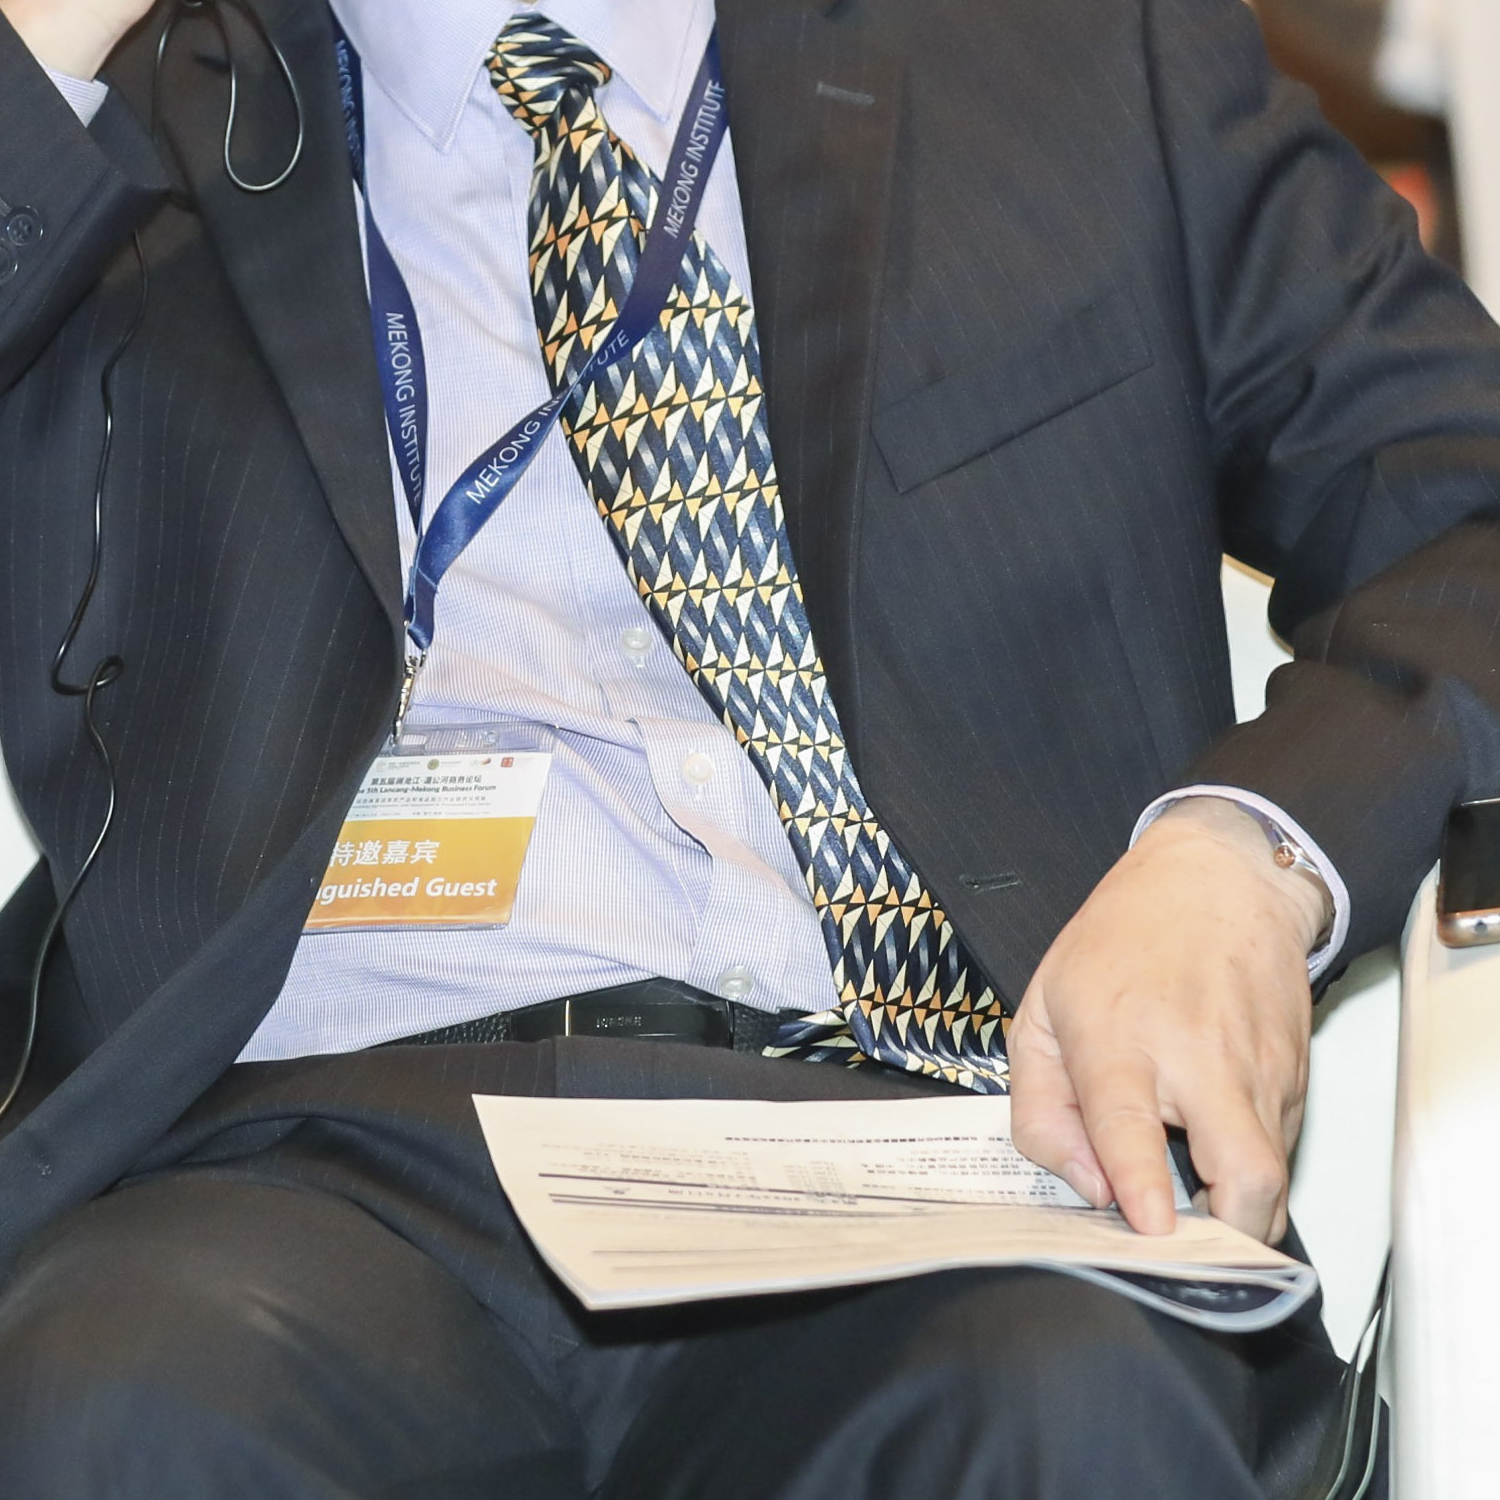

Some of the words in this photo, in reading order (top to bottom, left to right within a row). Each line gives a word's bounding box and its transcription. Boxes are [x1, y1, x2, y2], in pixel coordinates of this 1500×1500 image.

[663, 160, 699, 239] MEKONG
[385, 312, 415, 403] MEKONG
[465, 419, 542, 506] MEKONG
[425, 876, 498, 898] Guest
